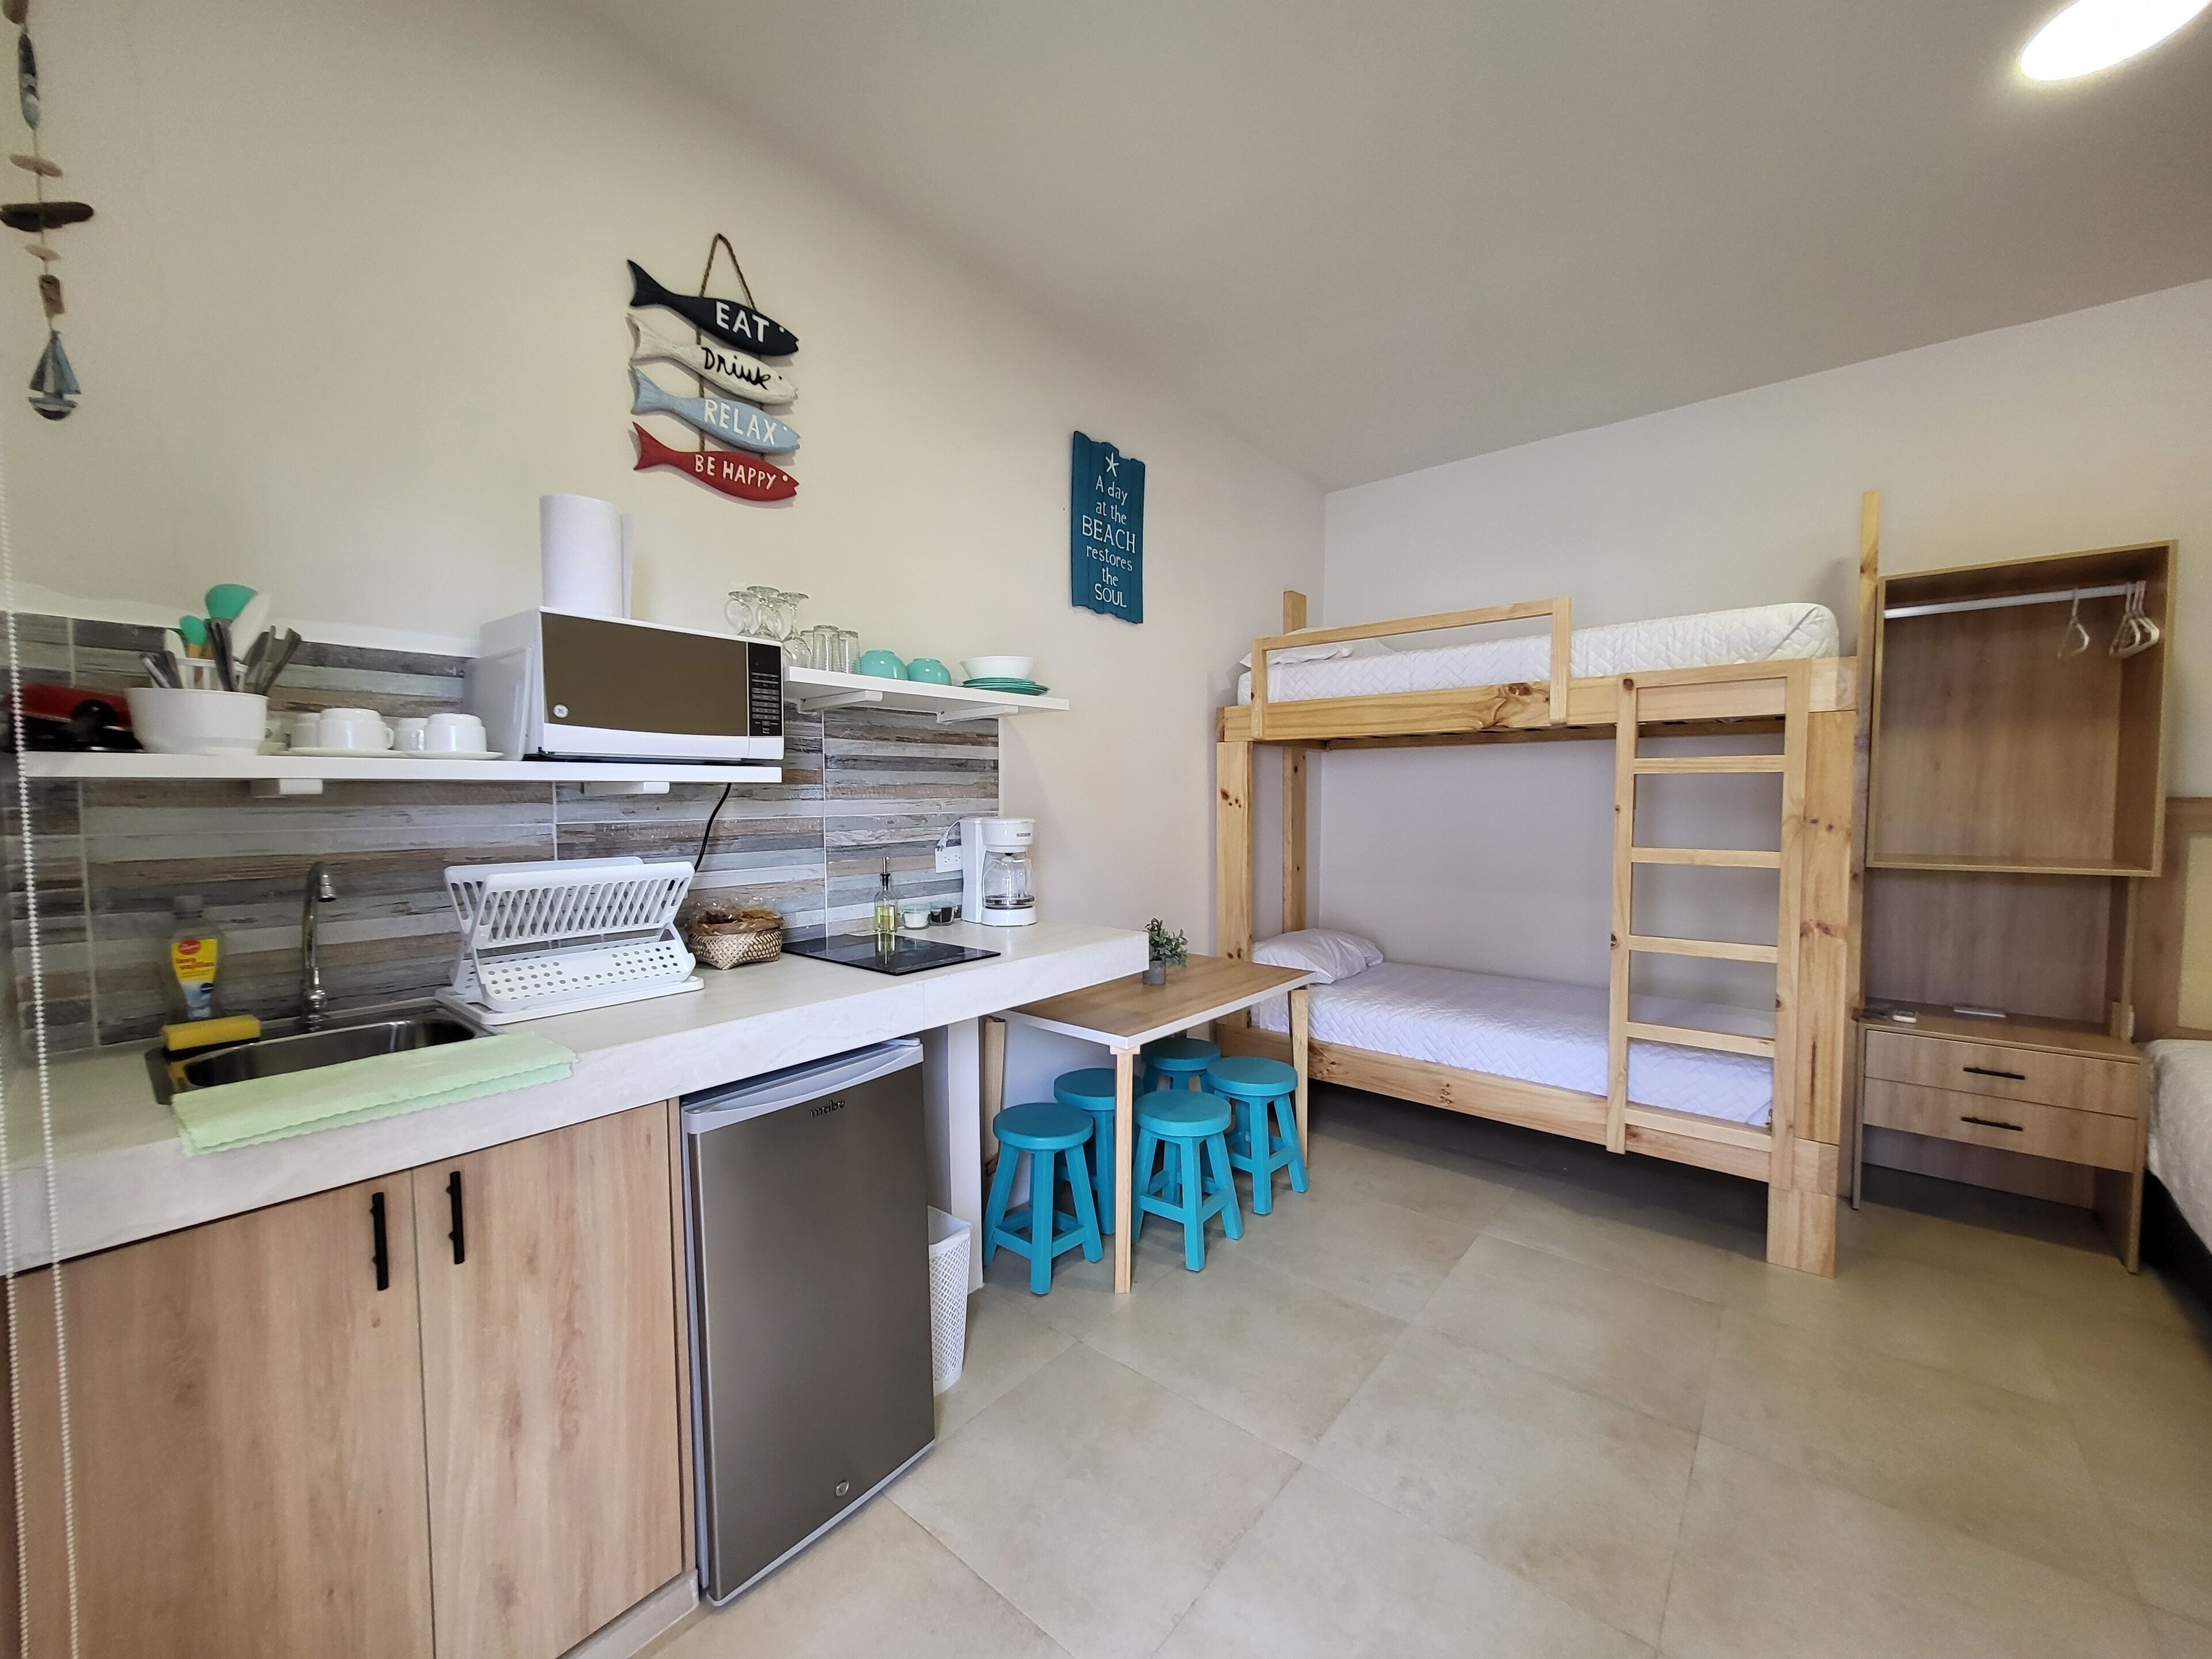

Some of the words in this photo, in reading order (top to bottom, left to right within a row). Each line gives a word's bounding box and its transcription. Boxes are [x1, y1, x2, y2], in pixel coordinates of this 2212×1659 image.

[716, 301, 769, 343] EAT
[704, 399, 777, 445] RELAX
[695, 454, 715, 476] BE
[723, 460, 776, 489] HAPPY
[1095, 475, 1104, 493] A
[1108, 481, 1128, 505] day
[1096, 501, 1107, 516] at
[1111, 505, 1127, 525] the
[1082, 514, 1136, 553] BEACH
[1086, 545, 1133, 571] restores
[1101, 567, 1119, 586] the
[1094, 583, 1127, 608] SOUL
[810, 1099, 845, 1118] mabe
